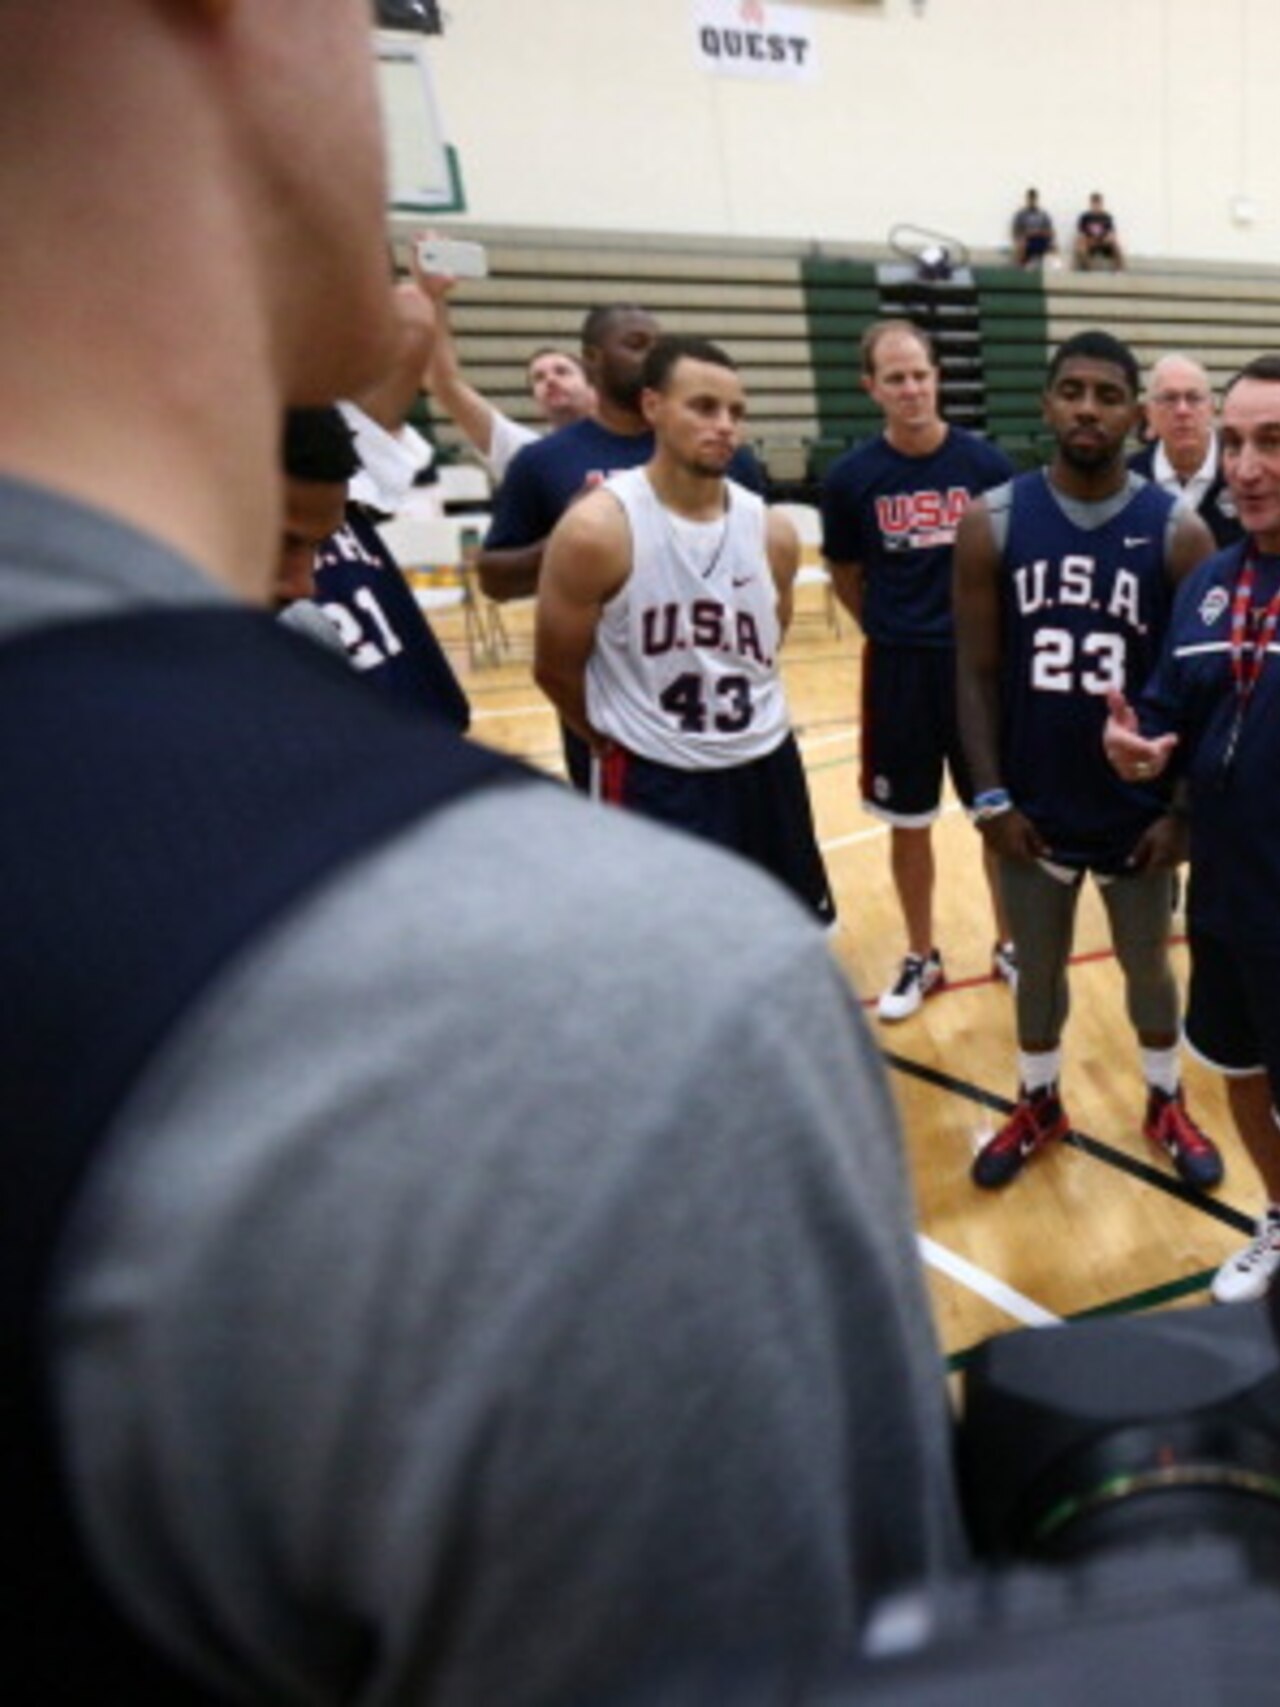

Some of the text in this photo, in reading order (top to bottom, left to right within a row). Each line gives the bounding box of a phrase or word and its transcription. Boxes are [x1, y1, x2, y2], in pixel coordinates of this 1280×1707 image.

[700, 26, 809, 65] QUEST
[876, 487, 969, 534] USA
[1014, 554, 1148, 634] U.S.A.
[642, 599, 773, 668] U.S.A.
[1030, 627, 1127, 695] 23
[659, 672, 755, 733] 43
